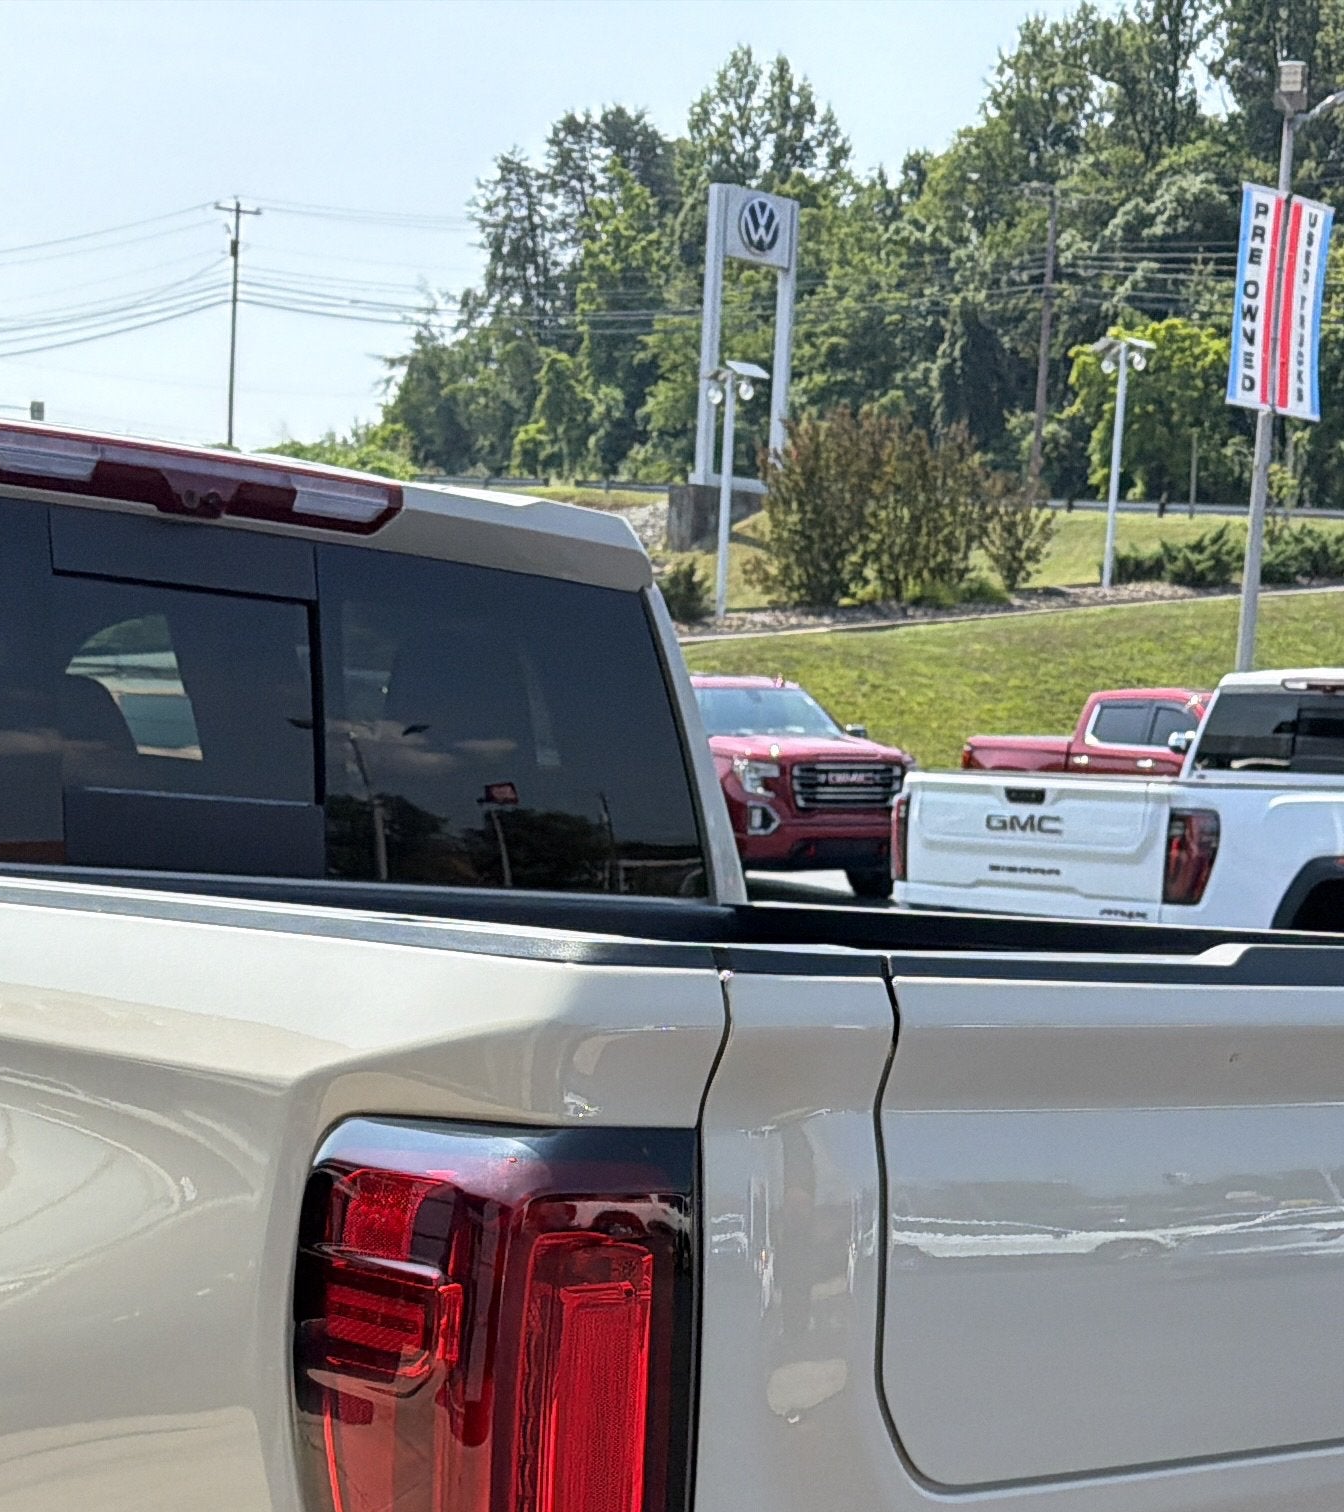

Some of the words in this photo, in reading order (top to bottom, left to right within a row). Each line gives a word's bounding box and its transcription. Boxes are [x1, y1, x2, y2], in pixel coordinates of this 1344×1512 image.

[1248, 202, 1269, 266] PRE
[1241, 279, 1259, 392] OWNED
[985, 814, 1063, 835] GMC
